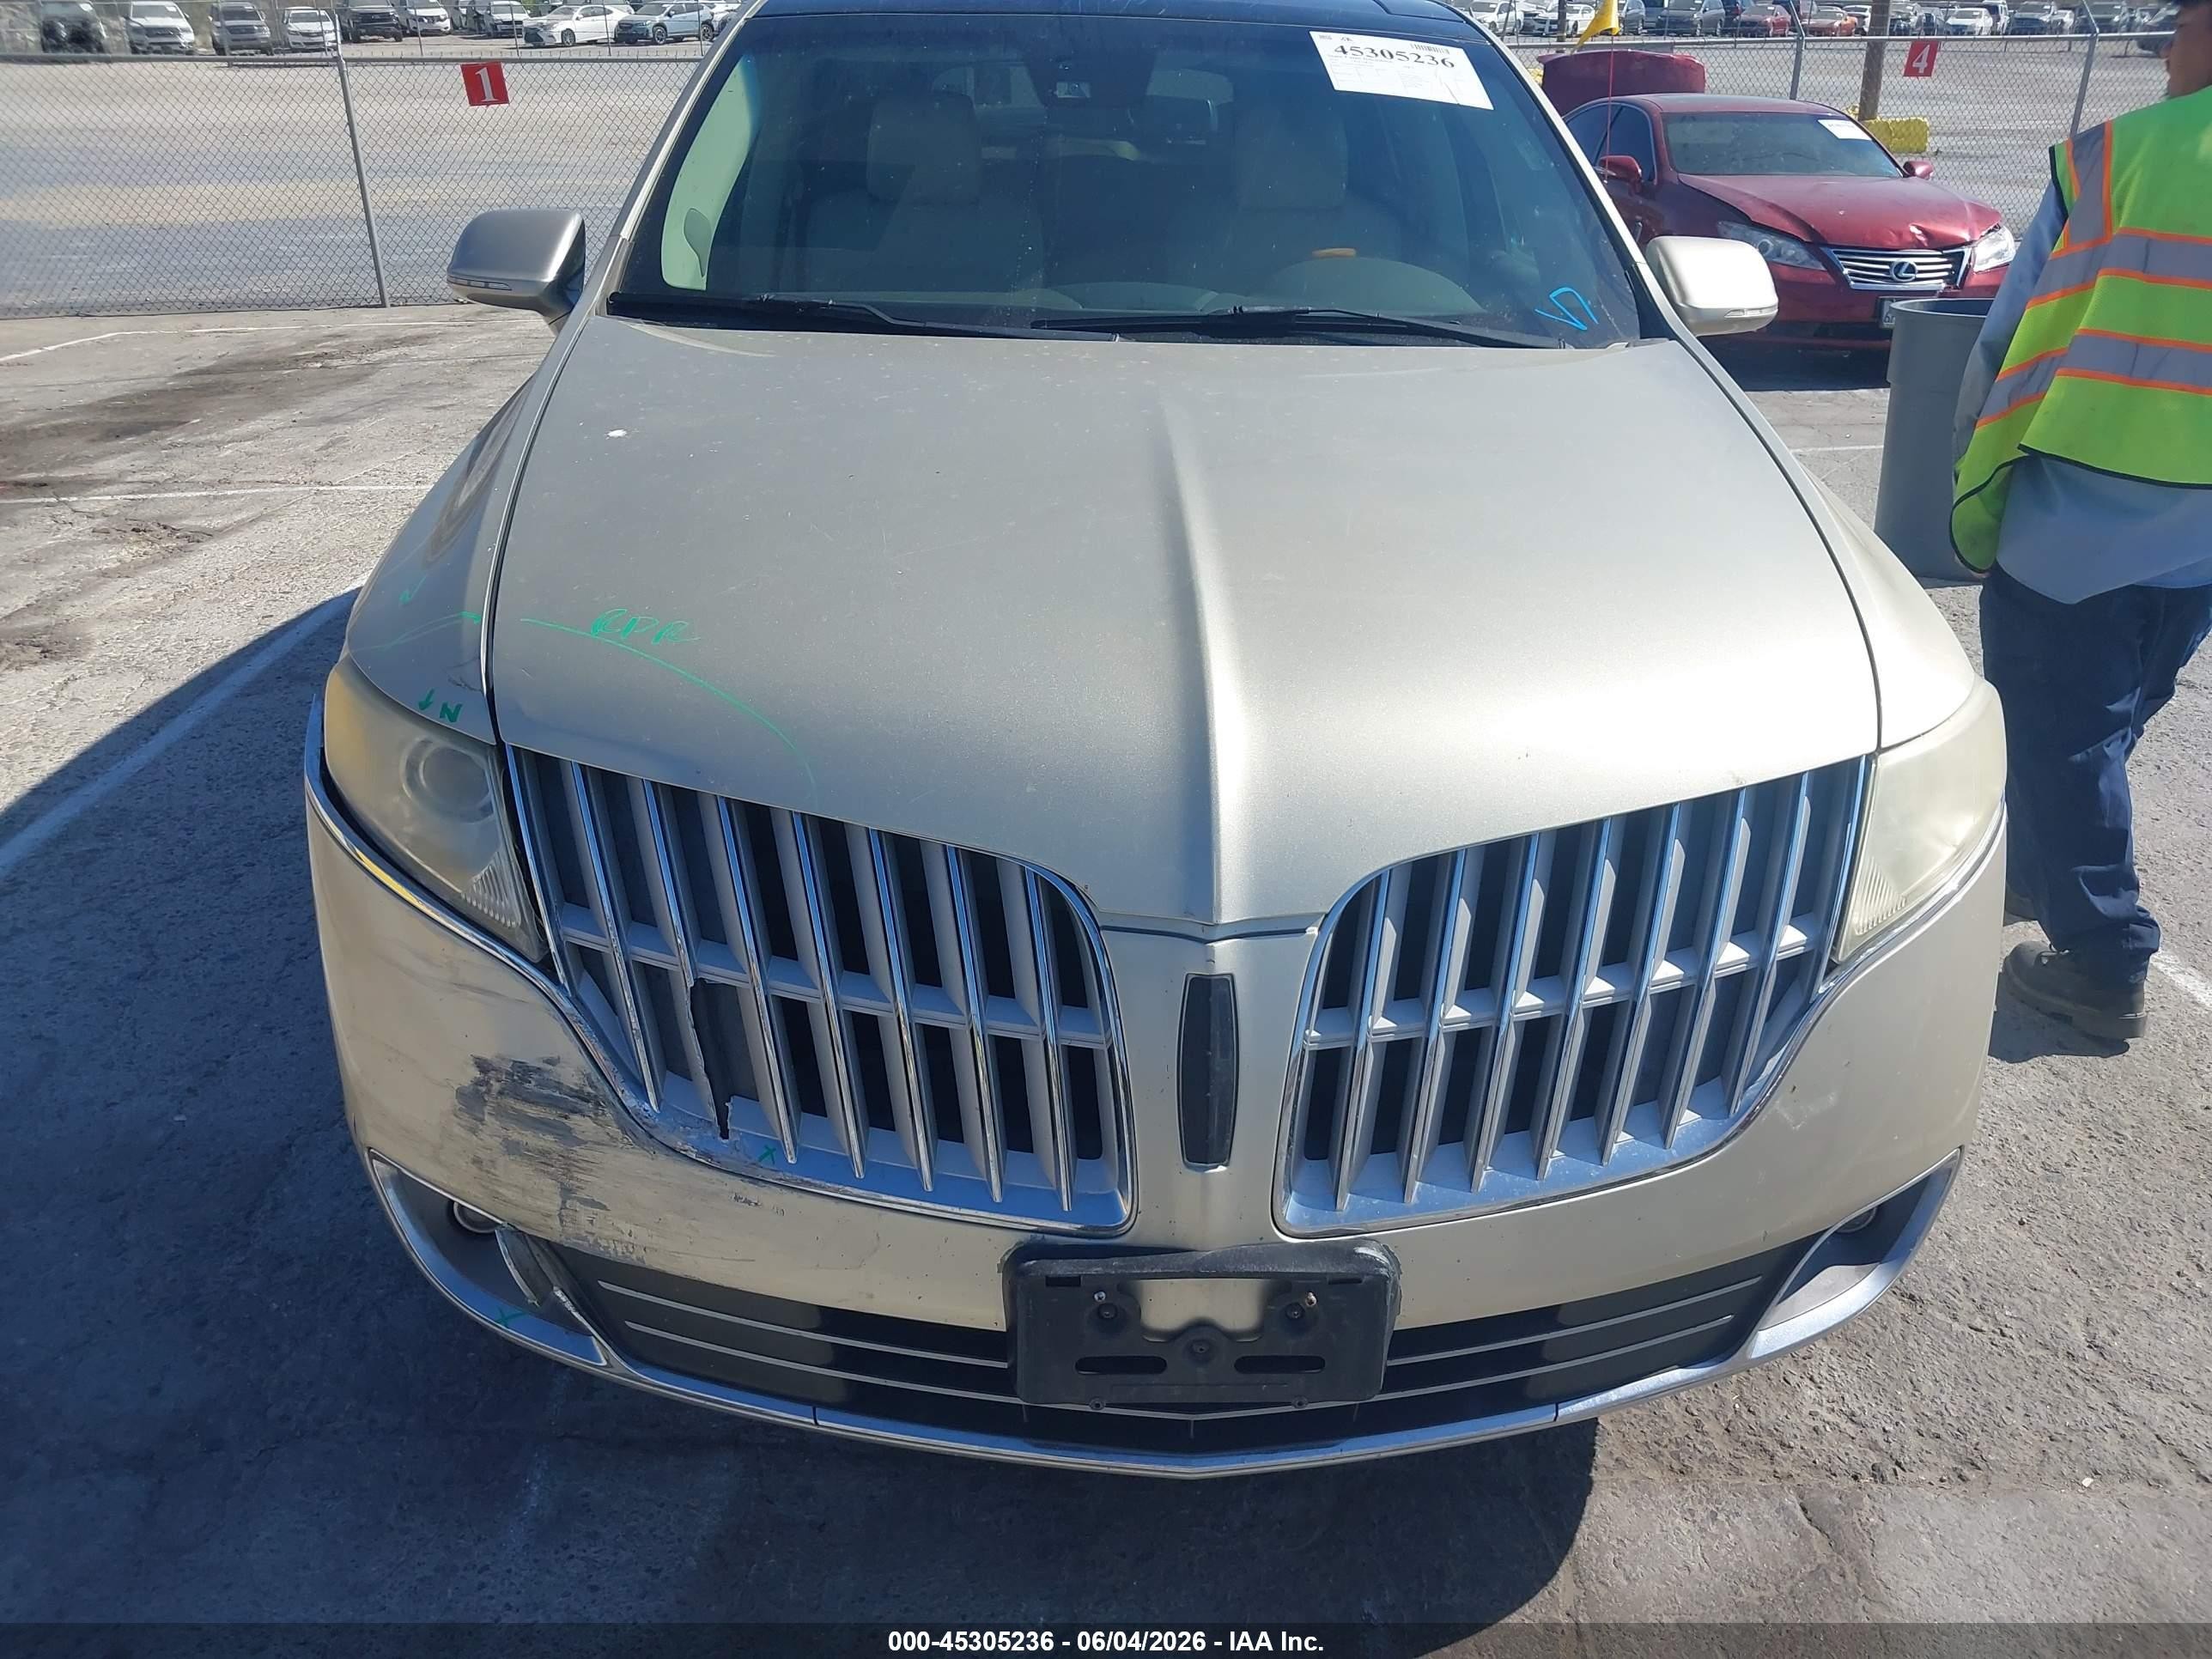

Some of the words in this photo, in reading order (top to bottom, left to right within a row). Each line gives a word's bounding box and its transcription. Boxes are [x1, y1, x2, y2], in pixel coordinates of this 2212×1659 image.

[1334, 44, 1455, 70] 45305236
[1912, 44, 1930, 74] 4
[474, 66, 500, 102] 1
[439, 702, 464, 723] N
